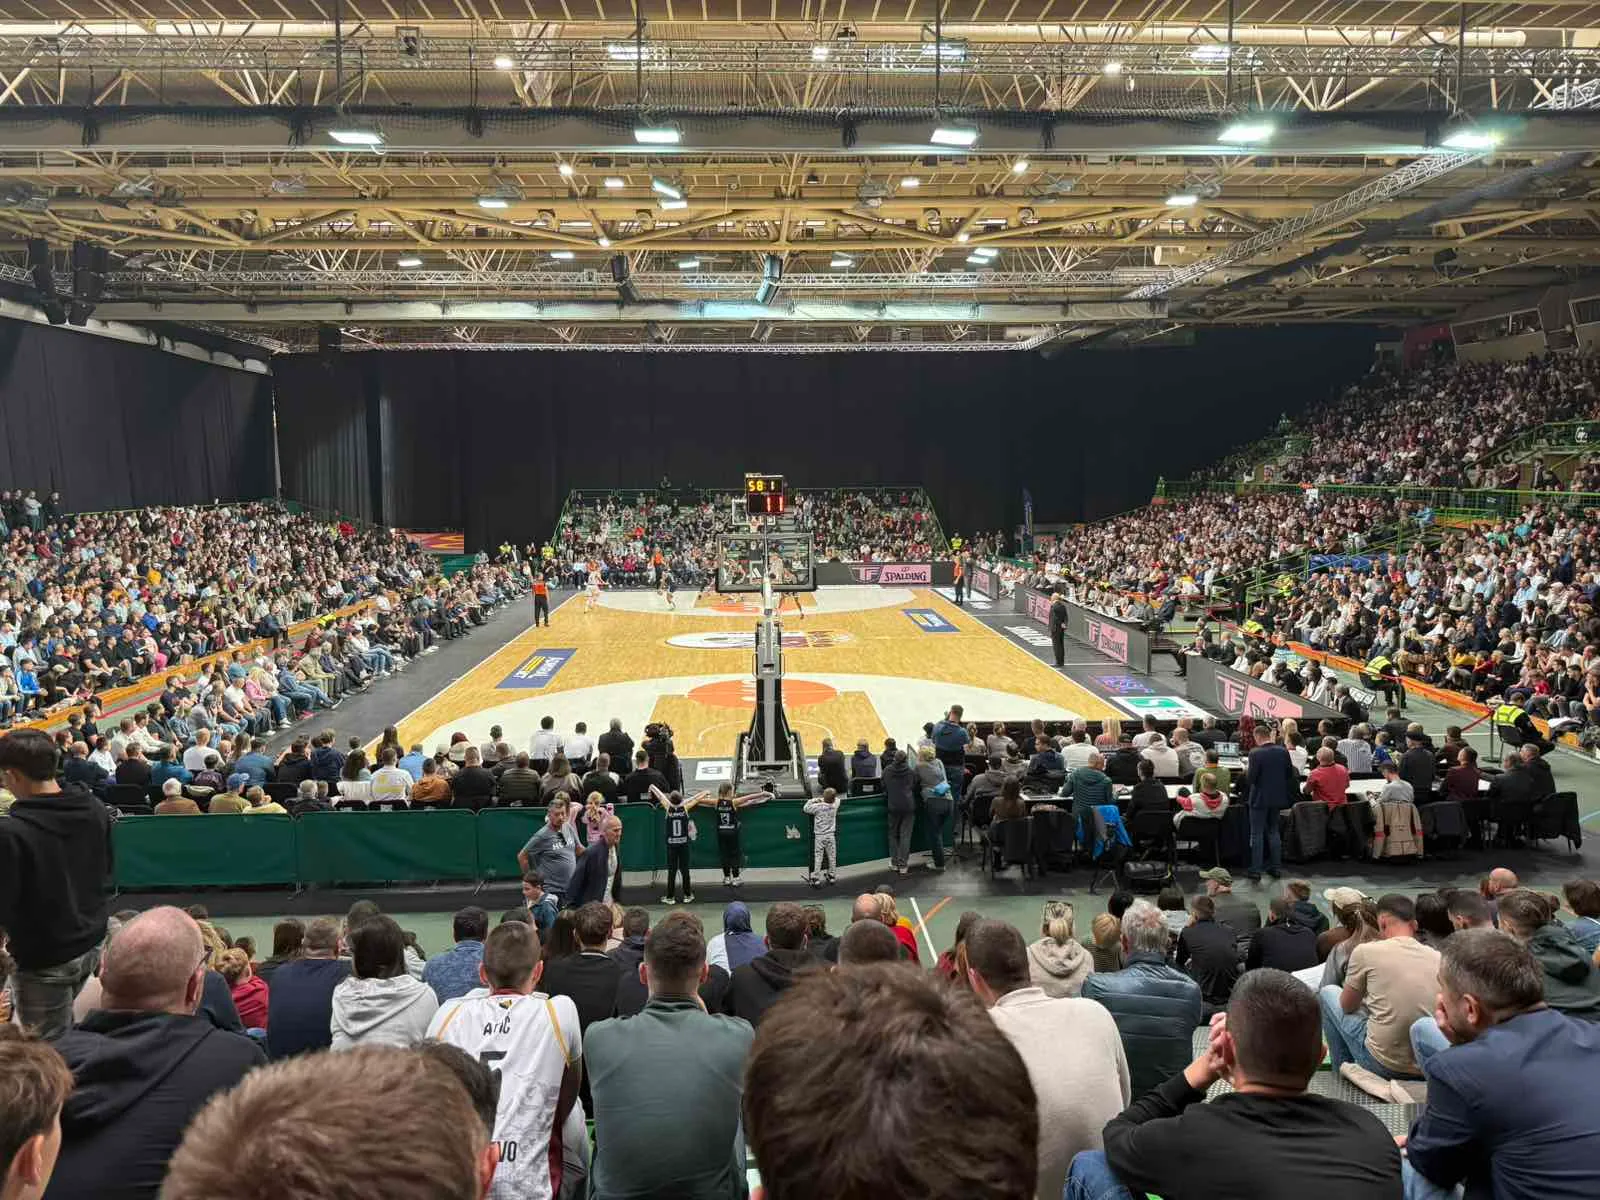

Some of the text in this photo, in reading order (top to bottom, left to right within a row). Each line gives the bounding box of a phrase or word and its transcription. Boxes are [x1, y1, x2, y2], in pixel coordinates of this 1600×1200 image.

[748, 480, 764, 491] 58
[884, 571, 927, 581] SPALDING
[1217, 675, 1245, 711] TF
[672, 819, 682, 836] 0
